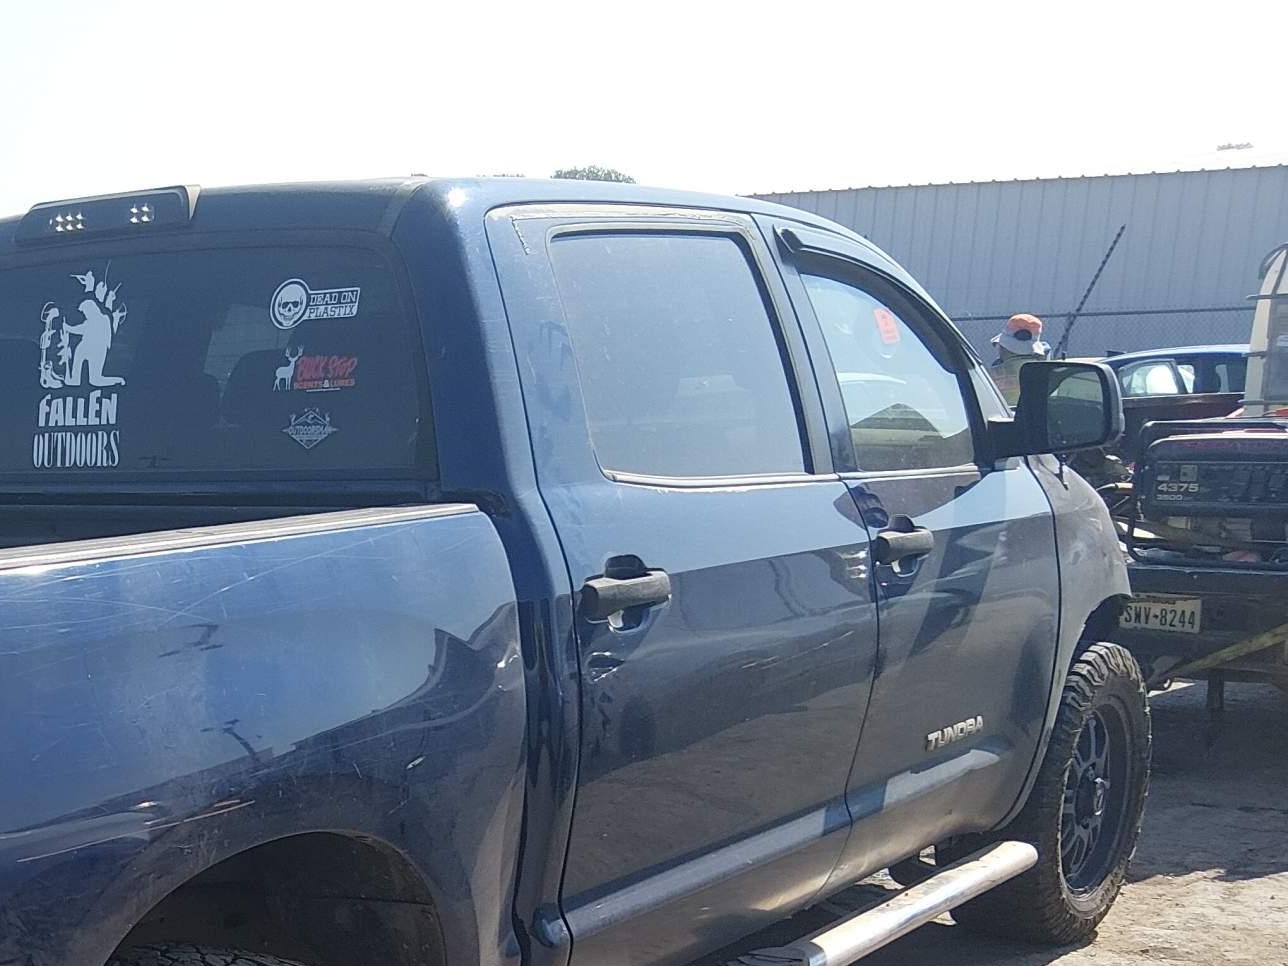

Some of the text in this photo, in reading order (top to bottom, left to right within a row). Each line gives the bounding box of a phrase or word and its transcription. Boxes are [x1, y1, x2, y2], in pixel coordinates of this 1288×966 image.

[308, 304, 355, 319] PLASTIX
[309, 291, 358, 306] DEAD ON
[38, 389, 118, 427] FALLEN
[33, 430, 119, 468] OUTDOORS
[1157, 483, 1199, 493] 4375
[926, 714, 984, 752] TUNDRA
